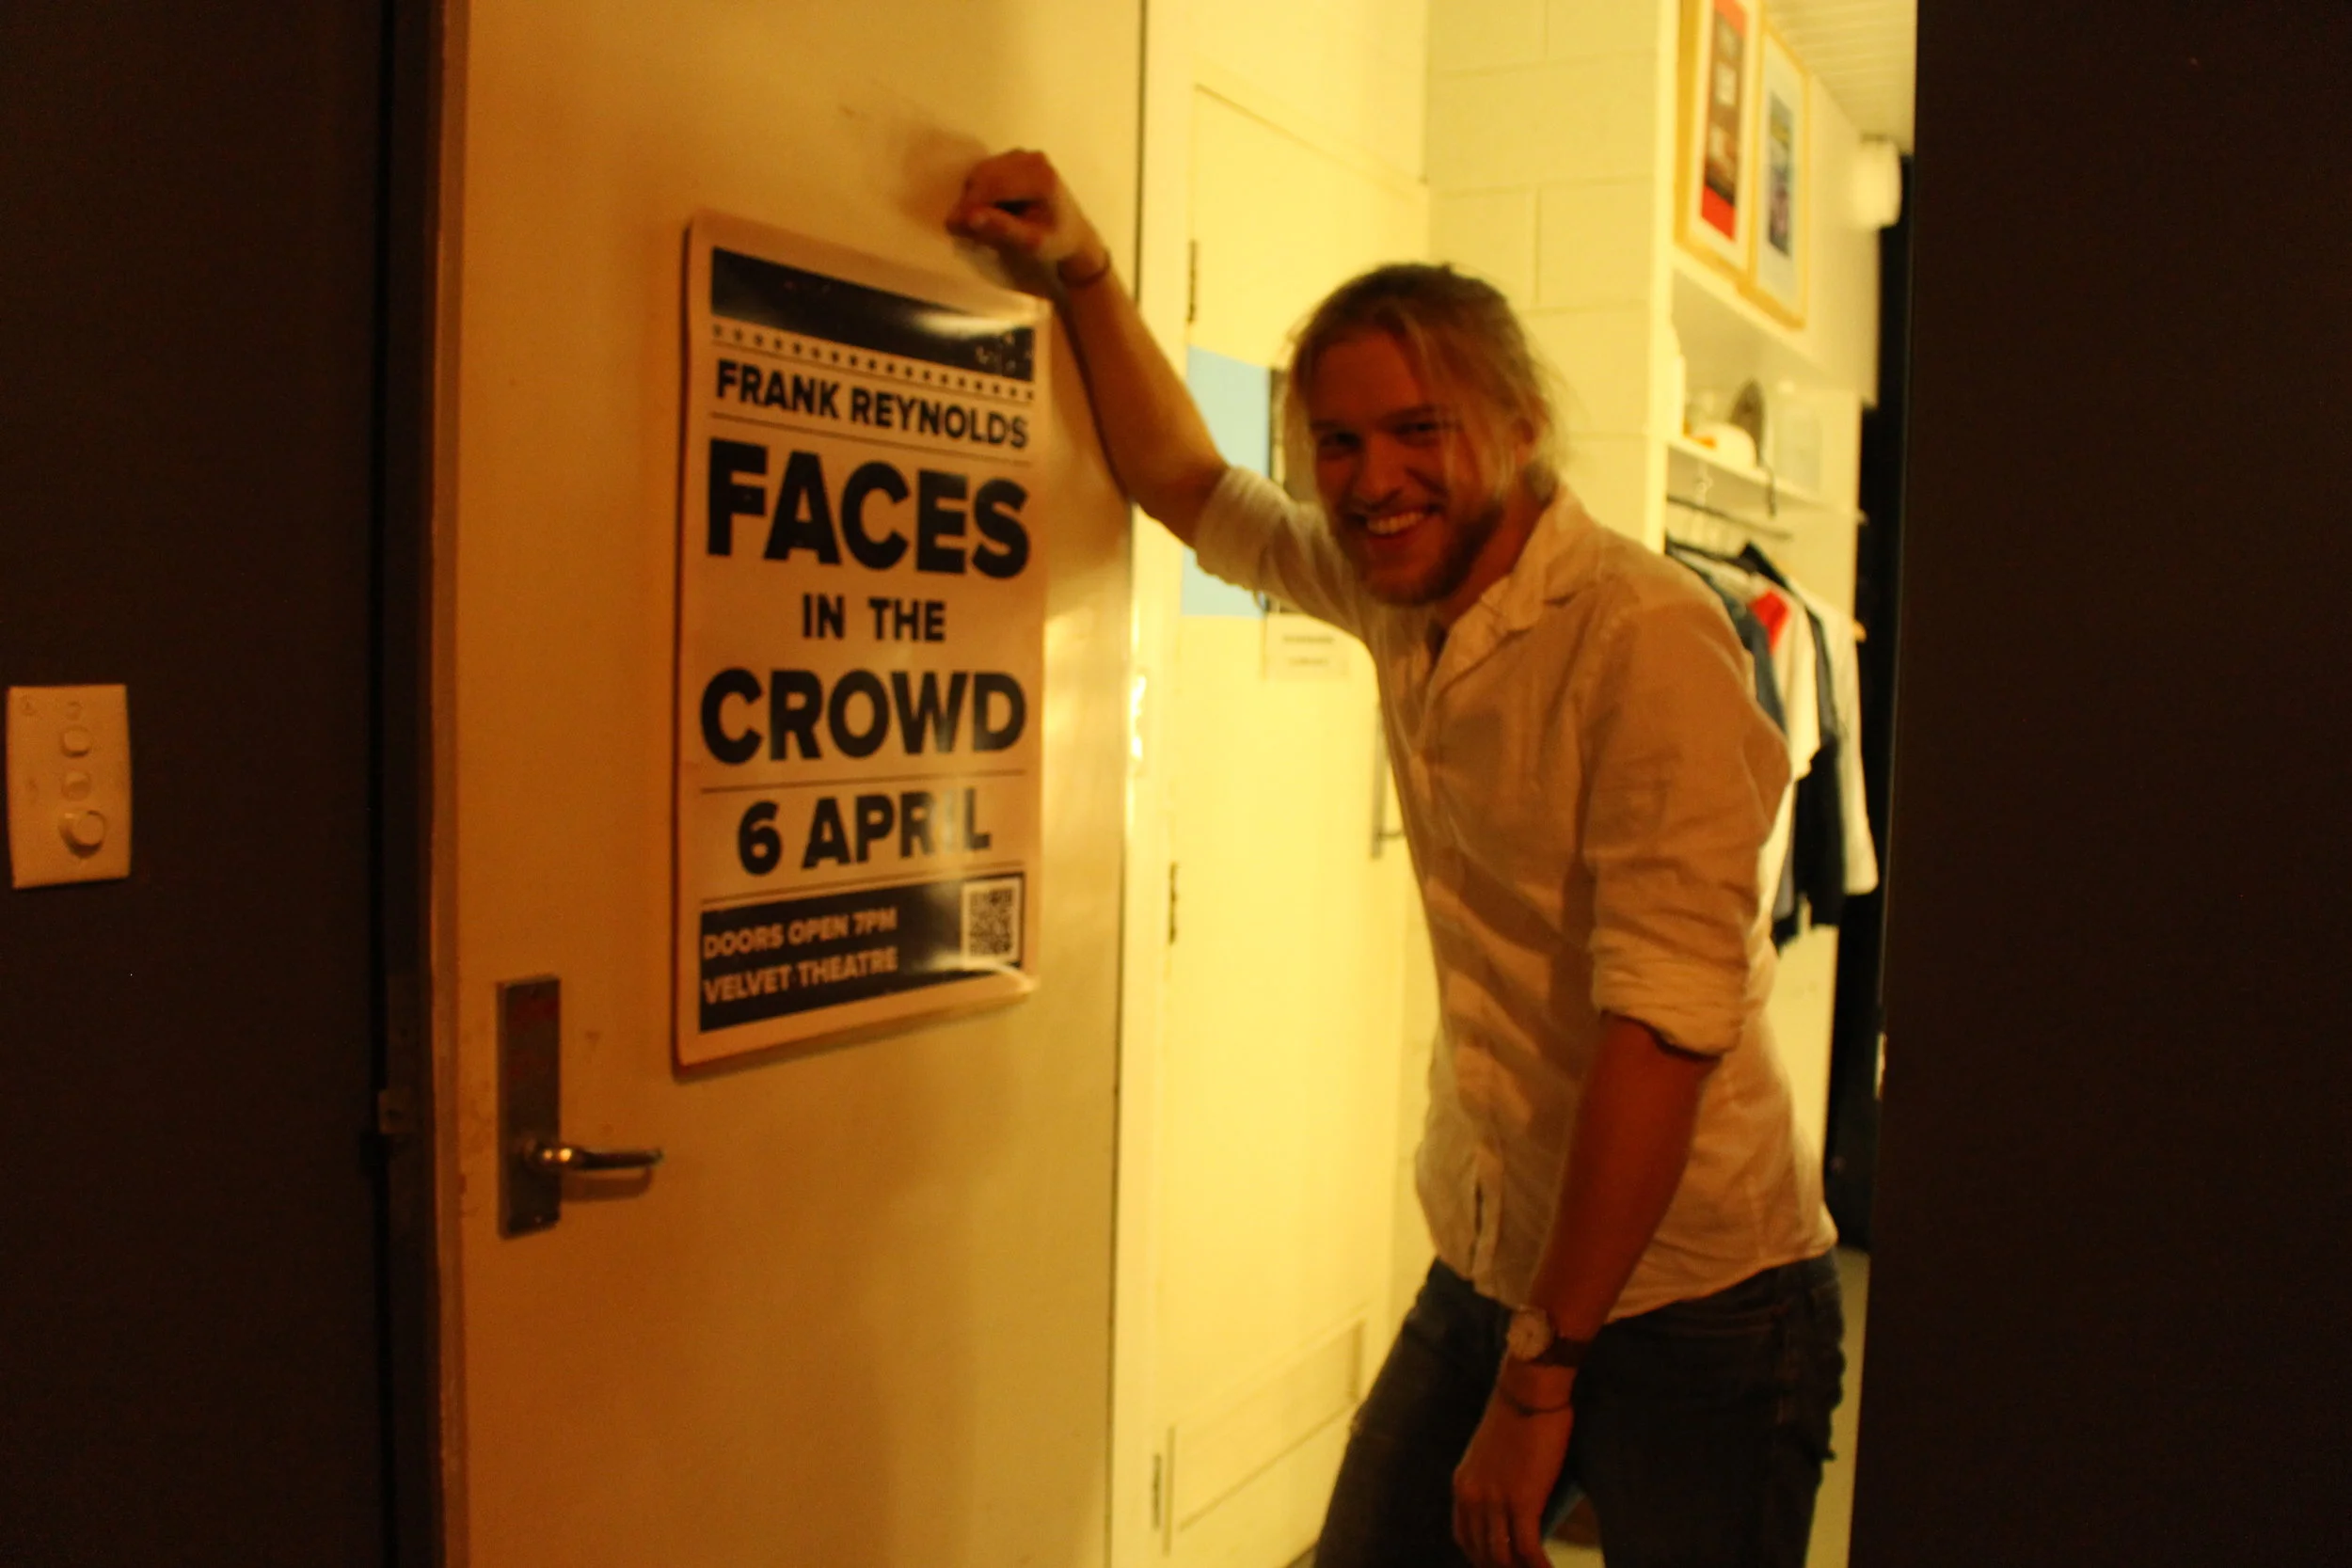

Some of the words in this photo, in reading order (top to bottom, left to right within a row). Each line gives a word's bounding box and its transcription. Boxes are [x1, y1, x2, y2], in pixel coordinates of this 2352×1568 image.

[716, 359, 840, 420] FRANK
[850, 388, 1028, 450] REYNOLDS
[707, 437, 1031, 579] FACES
[802, 593, 844, 639] IN
[868, 597, 946, 641] THE
[701, 667, 1026, 766] CROWD
[737, 800, 783, 875] 6
[802, 787, 992, 869] APRL
[703, 924, 784, 959] DOORS
[787, 914, 849, 946] OPEN
[852, 907, 898, 937] 7PM
[703, 965, 791, 1005] VELVET
[796, 946, 898, 987] THEATRE
